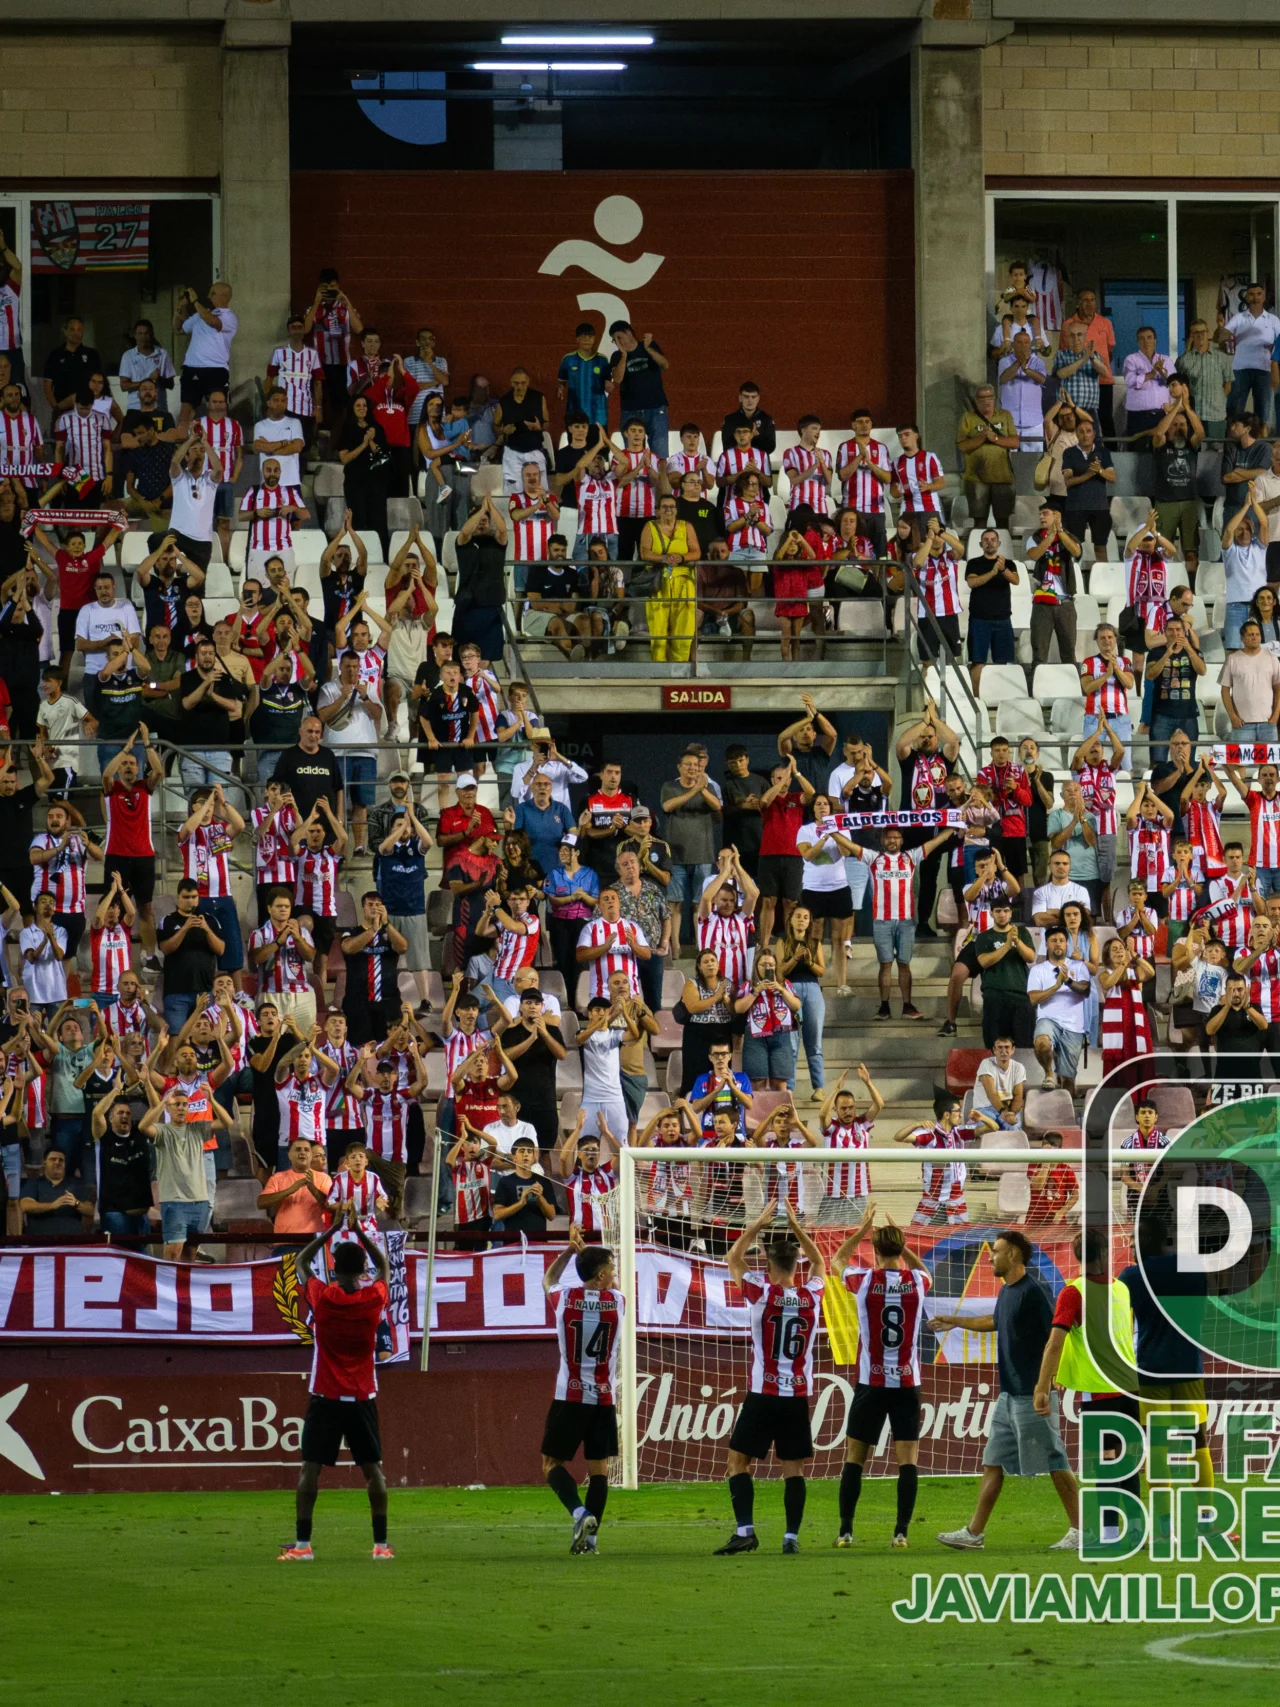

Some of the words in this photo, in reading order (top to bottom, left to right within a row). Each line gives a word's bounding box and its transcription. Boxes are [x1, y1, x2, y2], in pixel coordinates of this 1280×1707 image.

[94, 221, 141, 251] 27
[670, 691, 725, 703] SALIDA
[1229, 747, 1265, 761] VAMOS
[1267, 747, 1275, 761] A
[296, 766, 330, 775] adidas
[842, 811, 942, 828] ALDEALOBOS
[1210, 1083, 1264, 1104] ZERO
[388, 1300, 409, 1324] 16
[574, 1299, 618, 1312] NAVARRO
[774, 1295, 809, 1307] ZABALA
[768, 1314, 808, 1361] 16
[880, 1304, 905, 1349] 8
[568, 1319, 612, 1365] 14
[71, 1395, 350, 1454] CaixaBa
[637, 1372, 741, 1449] Unió
[812, 1373, 1000, 1457] Dporti
